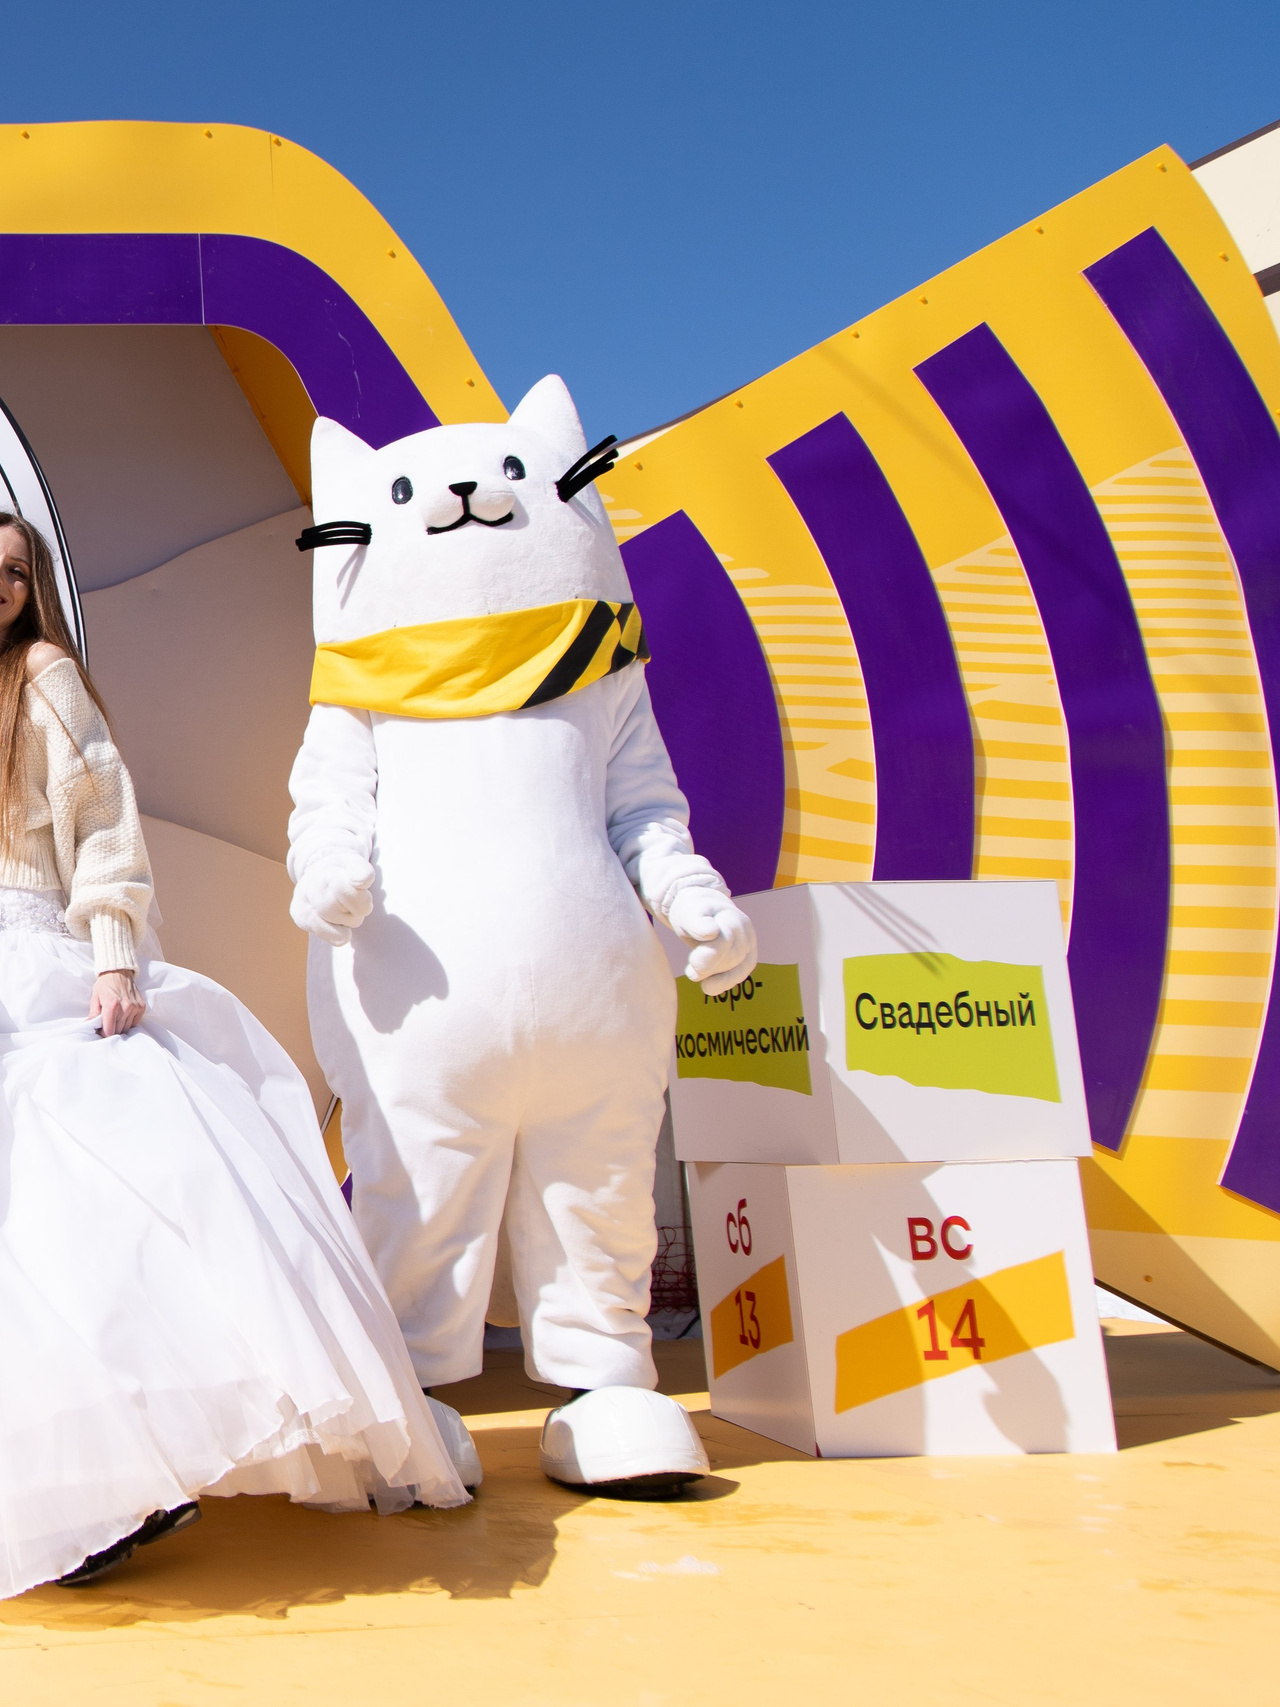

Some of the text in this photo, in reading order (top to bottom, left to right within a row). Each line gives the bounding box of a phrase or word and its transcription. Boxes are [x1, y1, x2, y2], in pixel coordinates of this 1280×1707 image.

[674, 1016, 810, 1059] космический
[855, 990, 1036, 1035] Свадебный
[726, 1198, 753, 1256] сб
[735, 1289, 761, 1349] 13
[916, 1298, 986, 1360] 14
